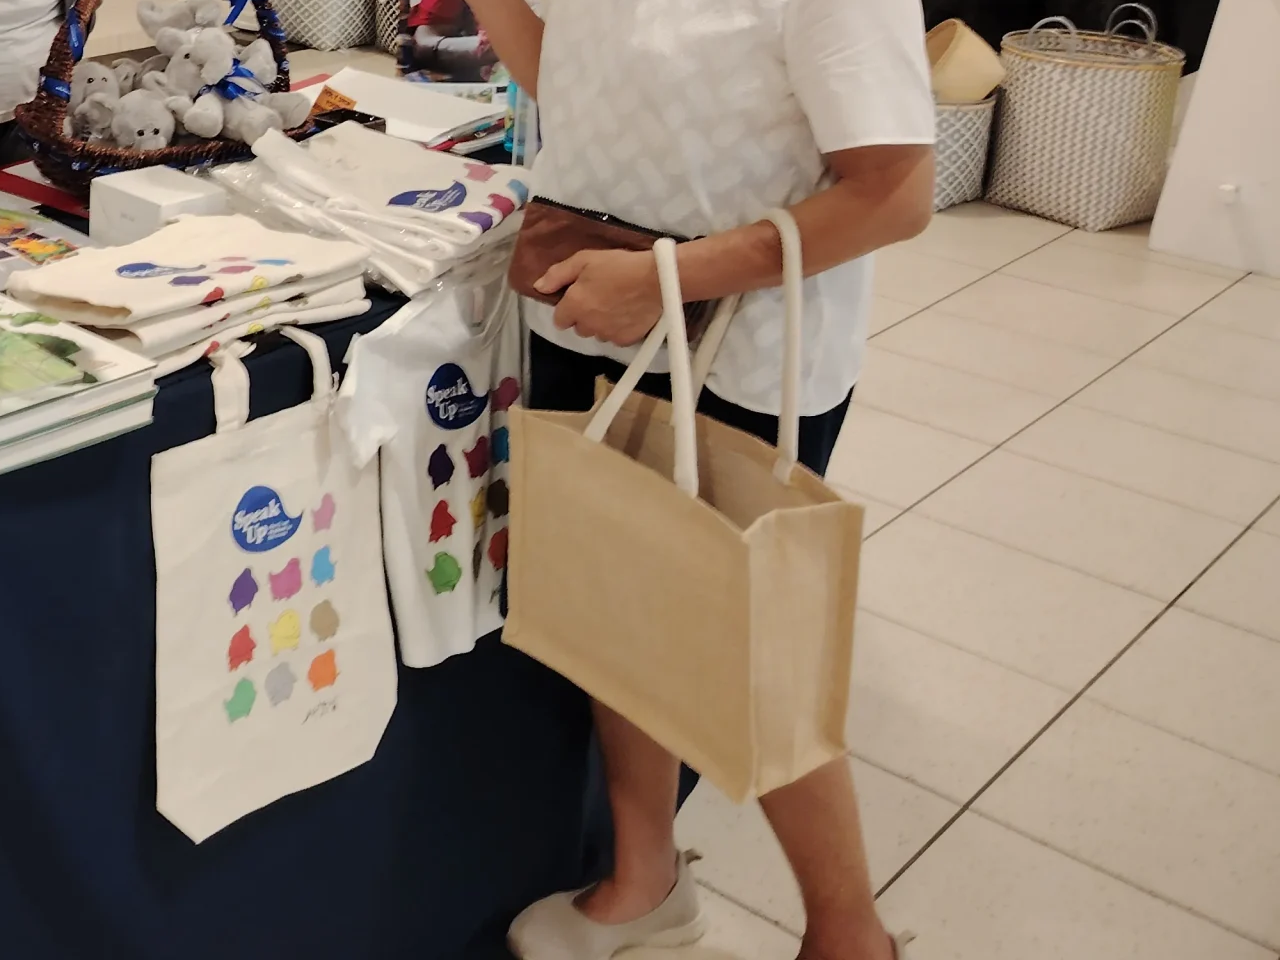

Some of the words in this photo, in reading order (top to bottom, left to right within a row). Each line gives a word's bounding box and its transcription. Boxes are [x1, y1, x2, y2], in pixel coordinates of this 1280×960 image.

[427, 377, 468, 407] Speak
[439, 400, 458, 421] Up
[234, 499, 281, 533] Speak
[246, 523, 269, 544] Up
